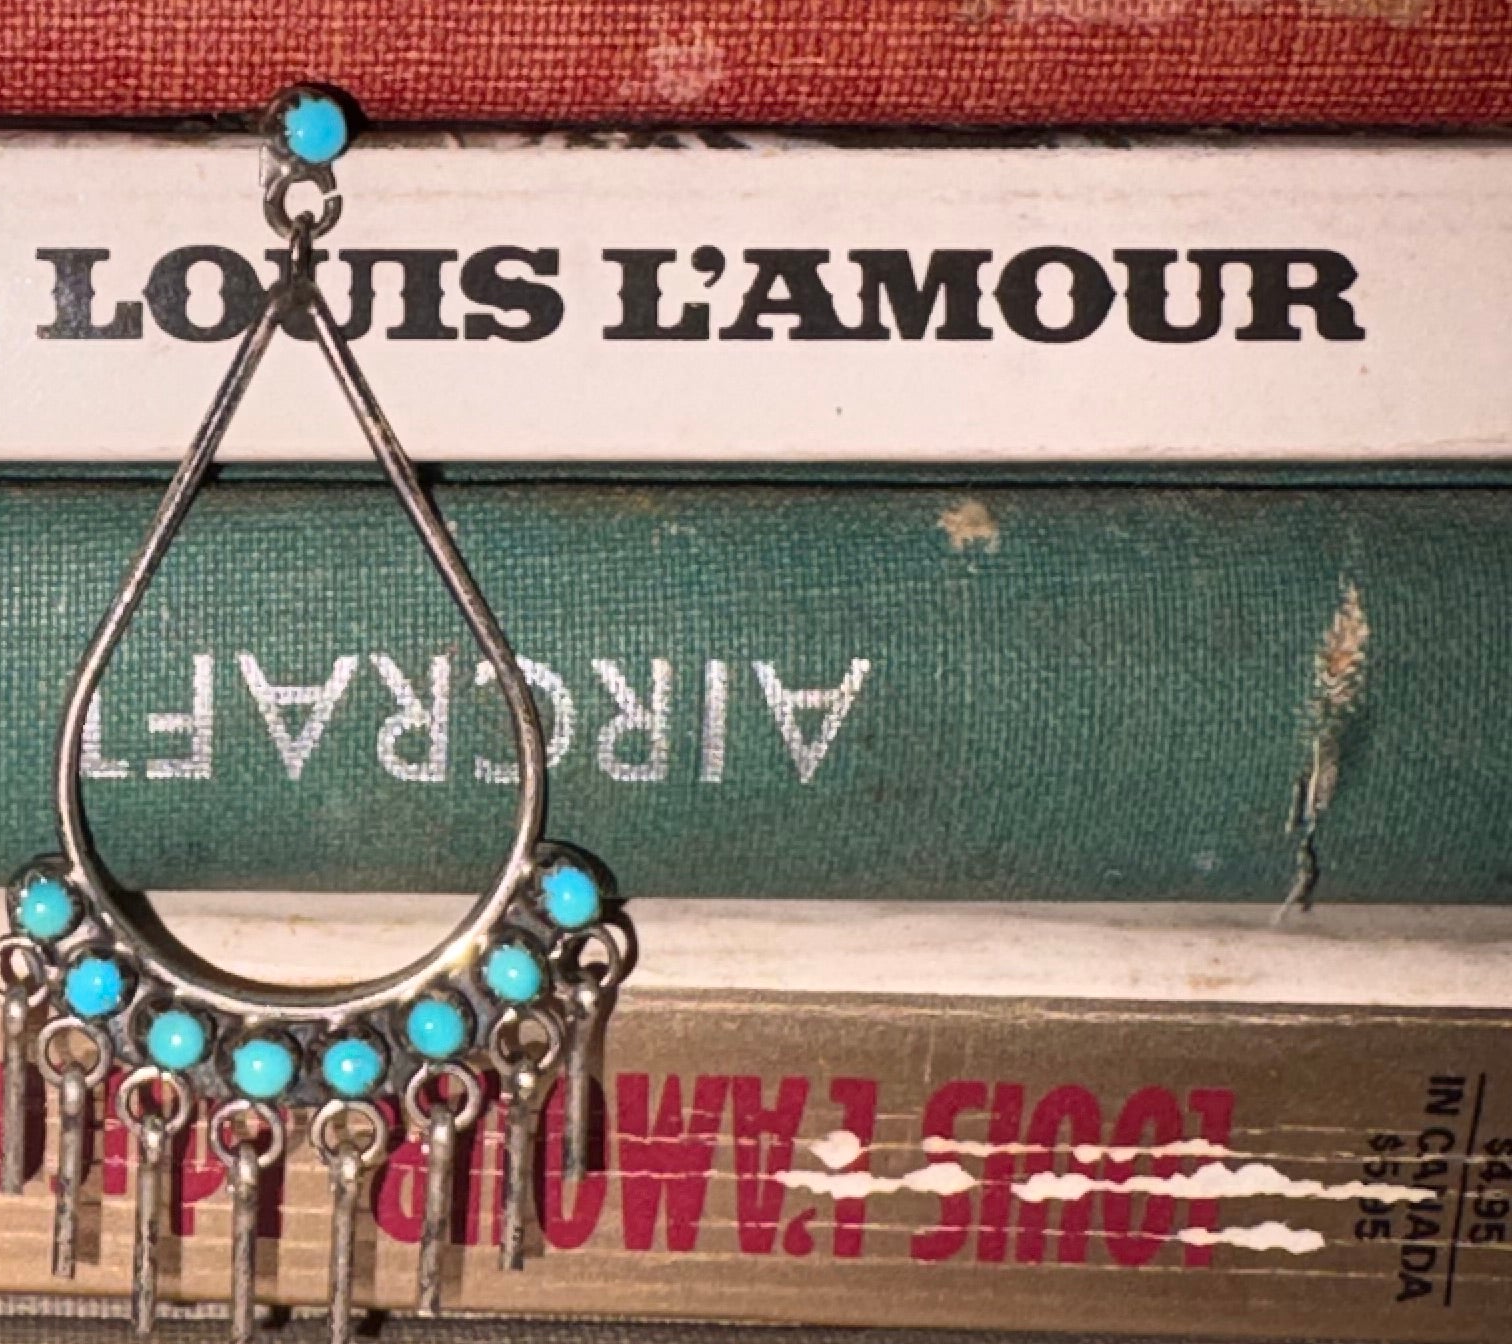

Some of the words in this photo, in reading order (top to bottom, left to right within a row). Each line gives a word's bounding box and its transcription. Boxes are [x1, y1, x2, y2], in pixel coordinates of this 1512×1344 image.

[35, 244, 565, 343] LOUIS
[602, 244, 1366, 344] L'AMOUR
[81, 652, 871, 786] AIRCRAFT
[1423, 1076, 1467, 1116] IN
[909, 1079, 1236, 1267] LOUIS
[1396, 1127, 1456, 1303] CANADA
